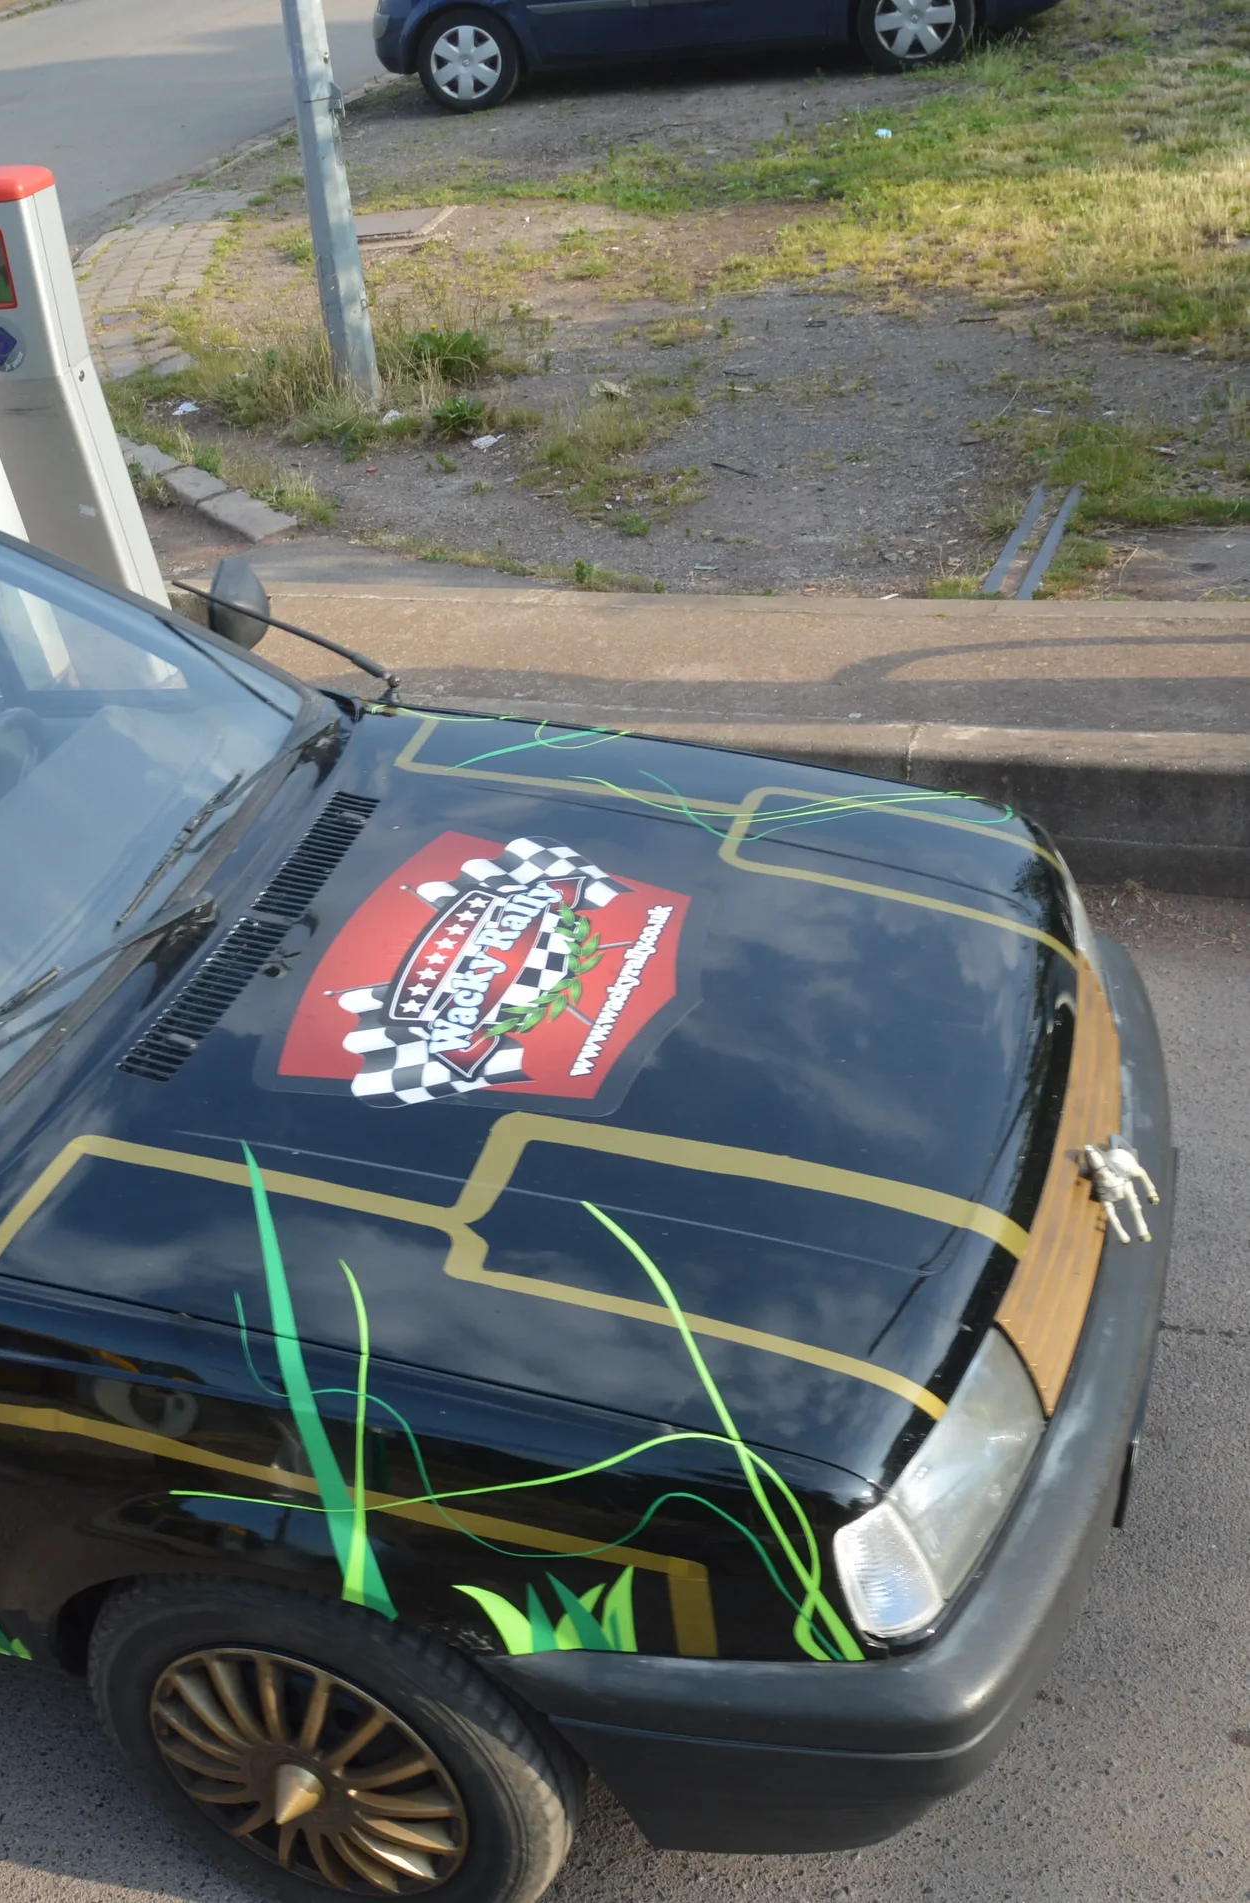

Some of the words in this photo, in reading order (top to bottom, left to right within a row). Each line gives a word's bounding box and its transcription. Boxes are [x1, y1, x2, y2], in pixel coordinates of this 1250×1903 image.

[429, 950, 507, 1054] Wacky
[474, 881, 564, 951] Rally
[570, 904, 674, 1077] www.wackyrally.co.uk
